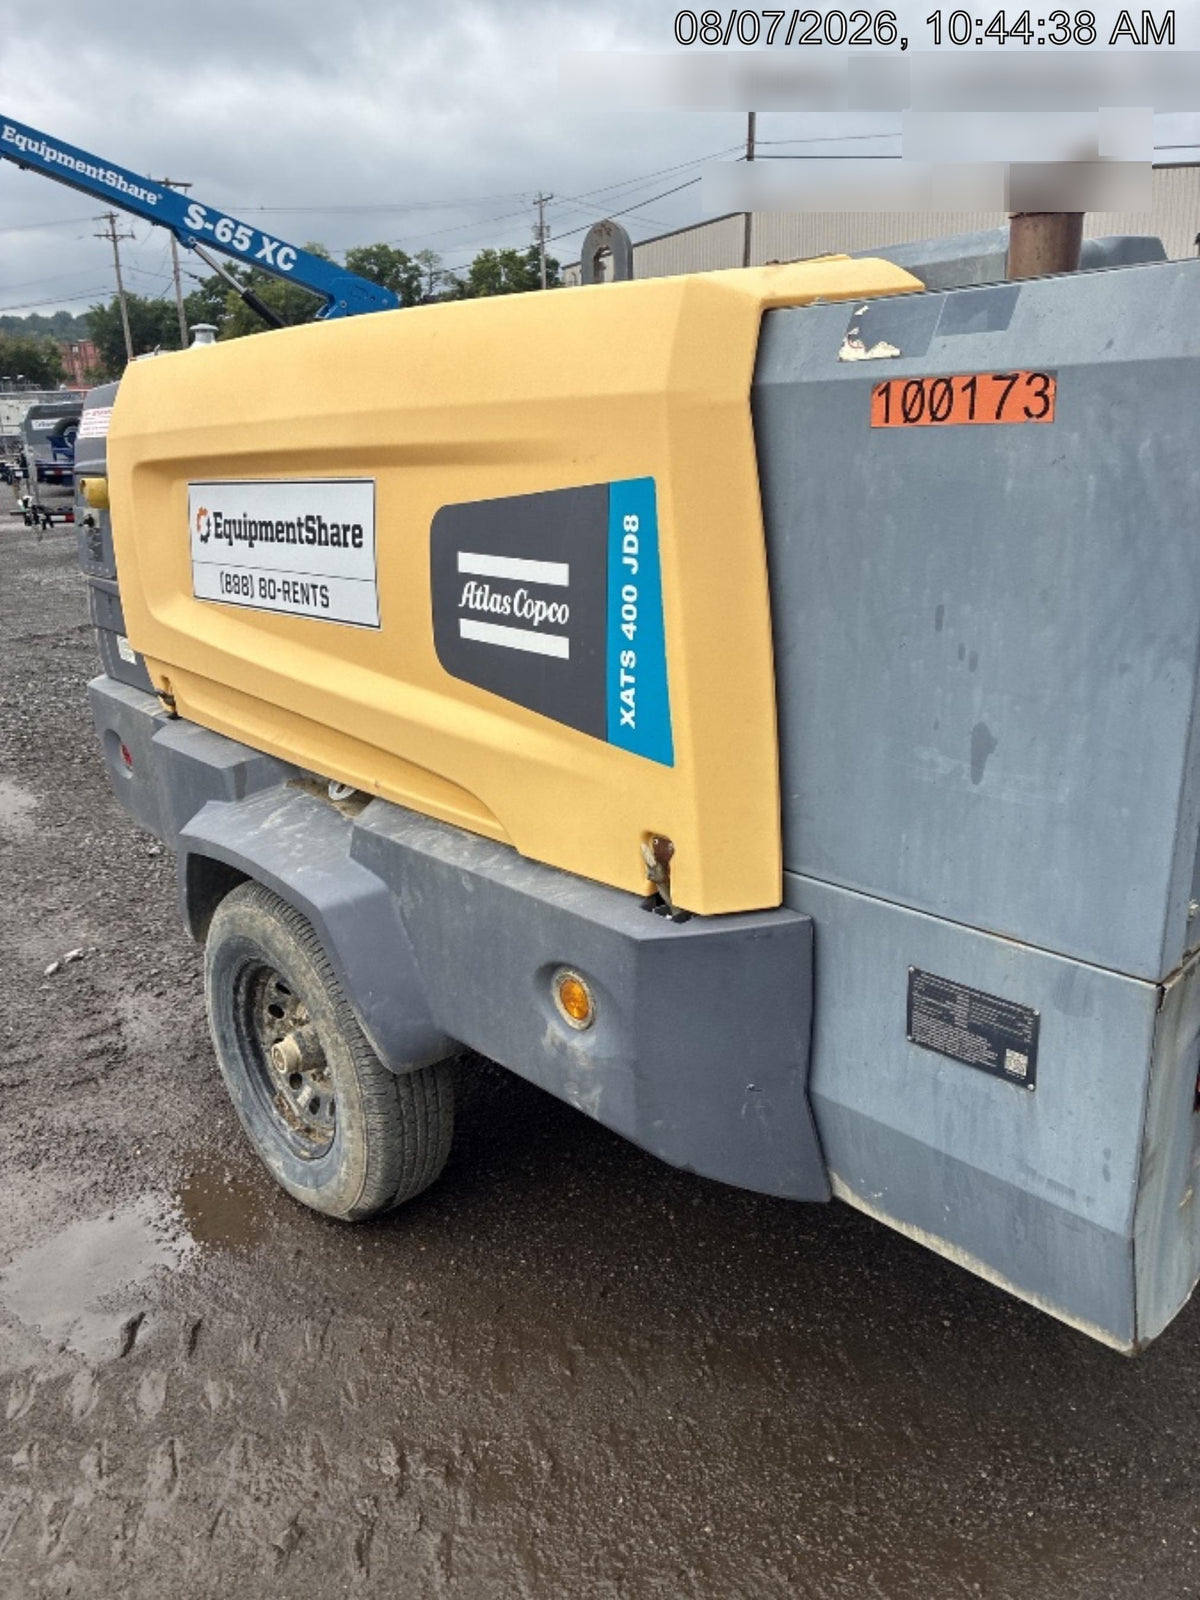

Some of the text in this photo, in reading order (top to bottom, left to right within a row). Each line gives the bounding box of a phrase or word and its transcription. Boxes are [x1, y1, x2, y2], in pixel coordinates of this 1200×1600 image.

[1, 124, 159, 205] EquipmentShare
[183, 204, 298, 271] S-65 XC
[877, 373, 1050, 423] 100173
[213, 512, 363, 548] EquipmentShare
[220, 571, 330, 608] (888) 80-RENTS
[458, 581, 570, 626] Atlas Copco
[619, 514, 640, 730] XATS 400 JD8
